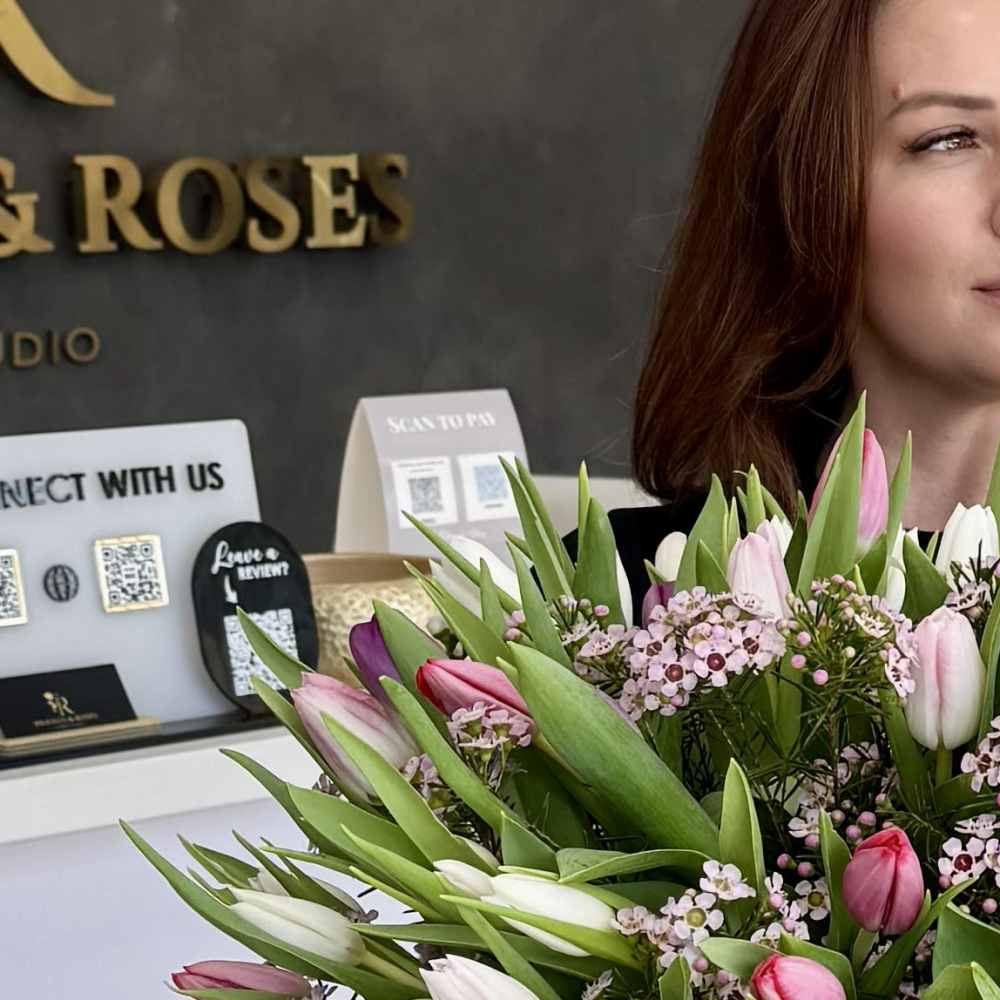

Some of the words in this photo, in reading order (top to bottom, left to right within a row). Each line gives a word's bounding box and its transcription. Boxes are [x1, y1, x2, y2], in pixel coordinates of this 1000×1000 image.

[74, 152, 416, 255] ROSES
[386, 415, 435, 433] SCAN
[436, 414, 464, 432] TO
[465, 411, 497, 428] PAY
[97, 465, 176, 500] WITH
[187, 462, 224, 492] US
[211, 540, 264, 575] Leave
